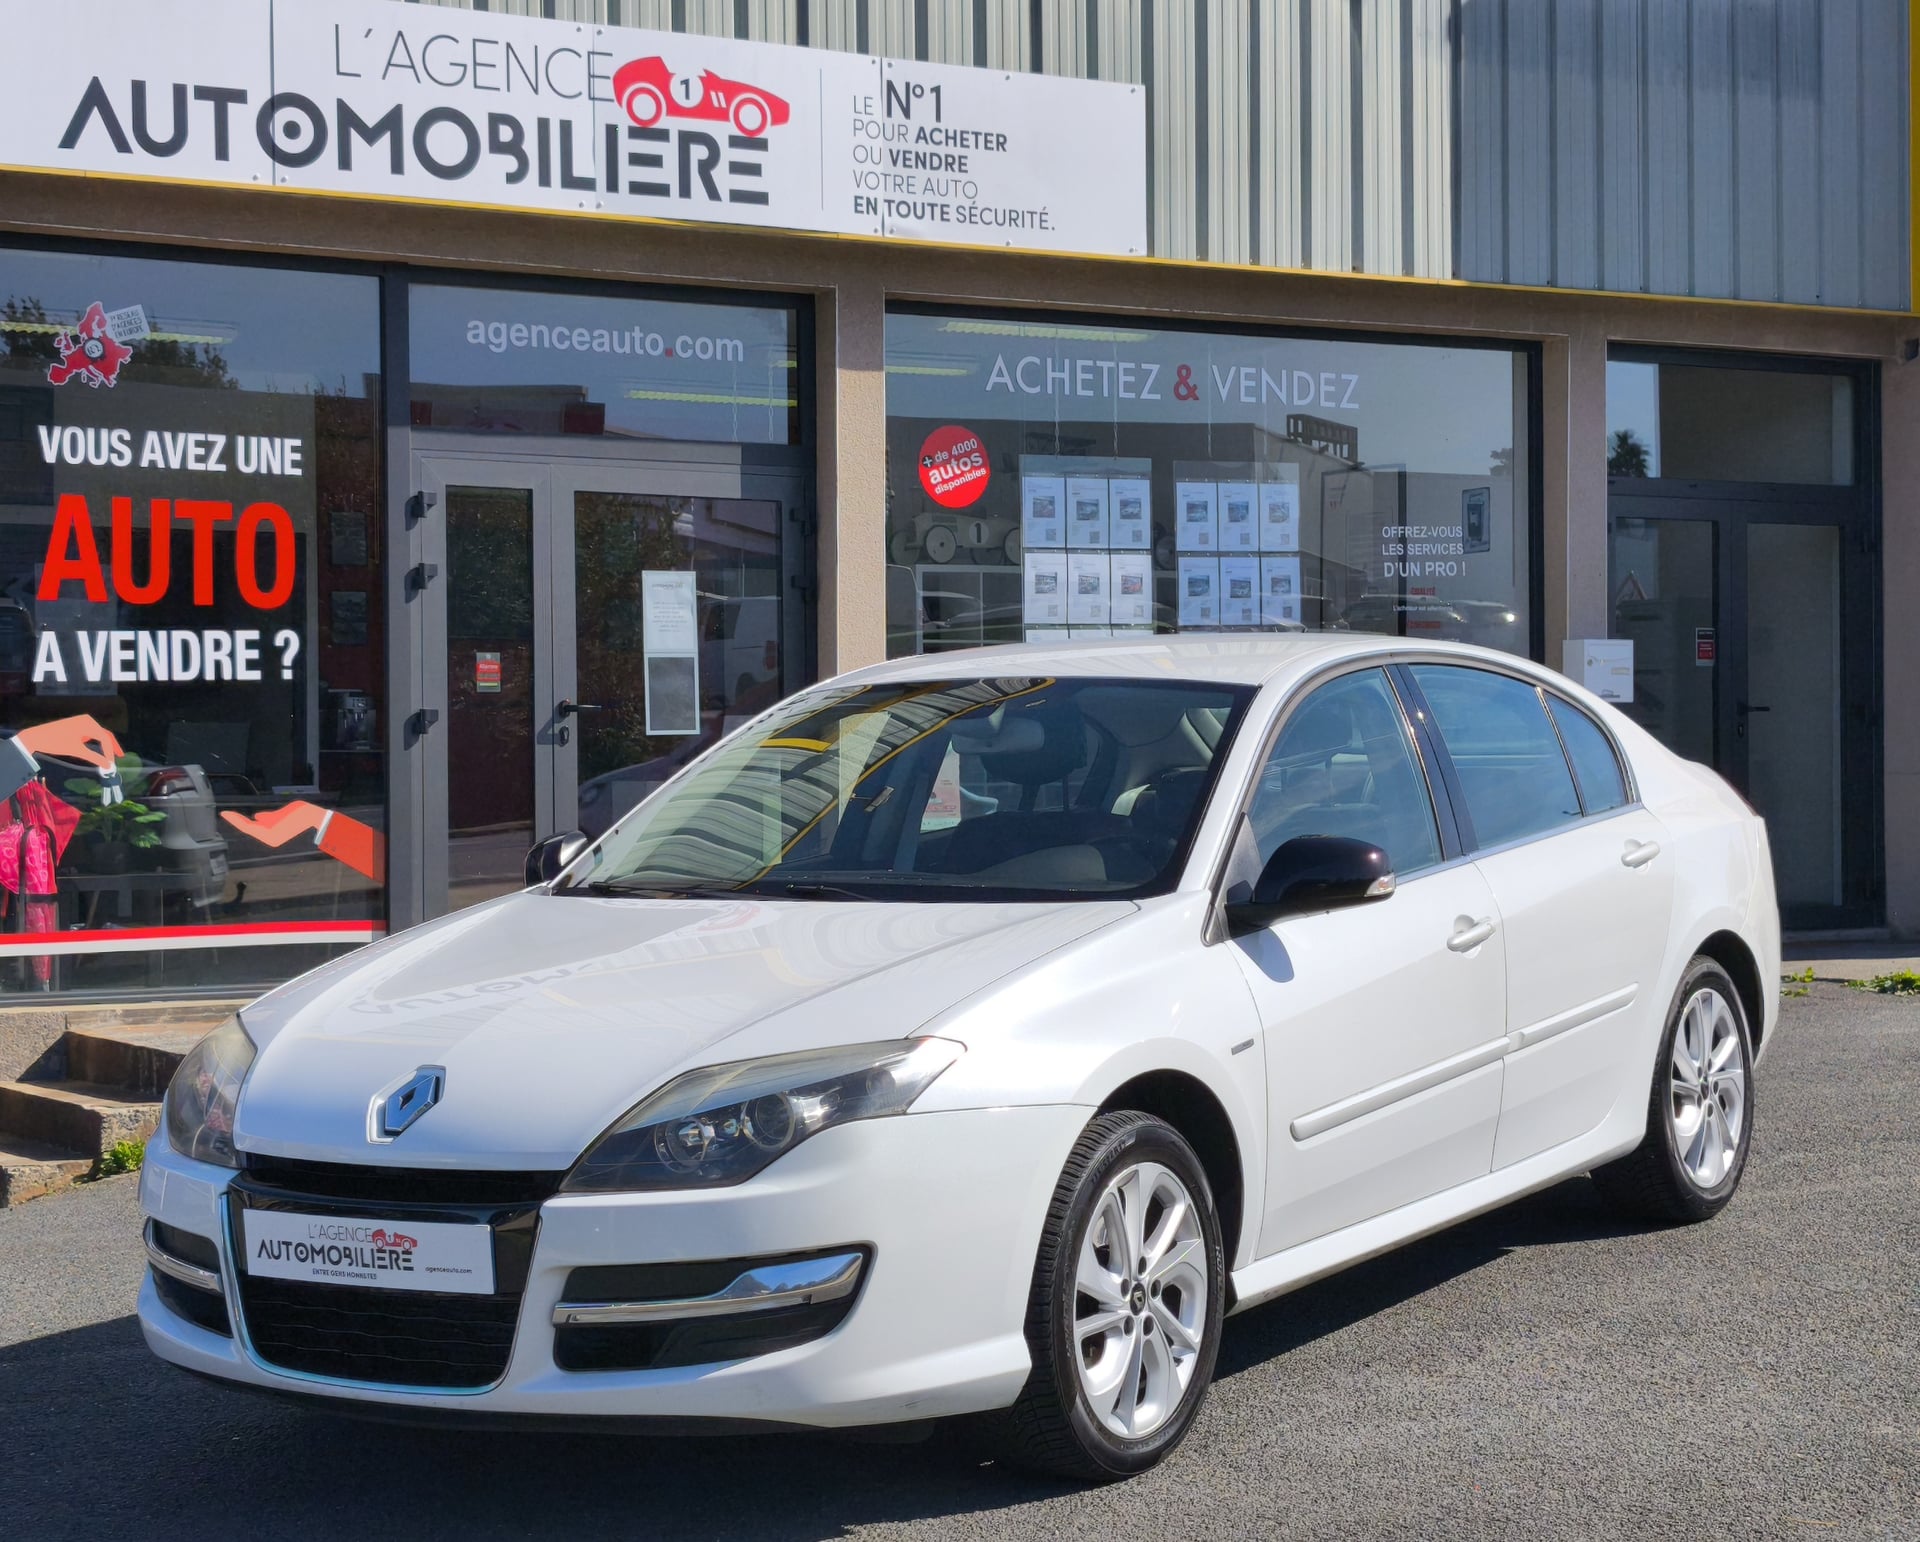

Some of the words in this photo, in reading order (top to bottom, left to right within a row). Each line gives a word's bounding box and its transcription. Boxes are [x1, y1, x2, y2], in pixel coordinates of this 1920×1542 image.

[335, 23, 614, 102] L'AGENCE
[853, 95, 873, 116] LE
[58, 76, 769, 206] AUTOMOBILIERE
[853, 120, 908, 144] POUR
[915, 127, 1008, 153] ACHETER
[853, 144, 882, 165] OU
[889, 149, 969, 174] VENDRE
[853, 169, 917, 194] VOTRE
[923, 175, 978, 201] AUTO
[853, 197, 878, 217] EN
[883, 199, 951, 223] TOUTE
[956, 200, 1057, 232] SÉCURITÉ.
[466, 319, 744, 362] agenceauto.com
[985, 353, 1162, 400] ACHETEZ
[1173, 364, 1200, 401] &
[1212, 366, 1360, 410] VENDEZ
[38, 425, 132, 466] VOUS
[141, 431, 227, 472] AVEZ
[236, 436, 303, 476] UNE
[935, 450, 949, 462] de
[951, 438, 978, 456] 4000
[929, 452, 983, 485] autos
[934, 467, 987, 495] disponibles
[1382, 526, 1463, 538] OFFREZ-VOUS
[36, 493, 296, 610] AUTO
[1382, 543, 1404, 556] LES
[1407, 543, 1464, 555] SERVICES
[1383, 561, 1420, 577] D'UN
[1425, 561, 1457, 577] PRO
[33, 630, 67, 682] A
[77, 629, 262, 682] VENDRE
[273, 629, 300, 681] ?
[308, 1223, 372, 1243] L'AGENCE
